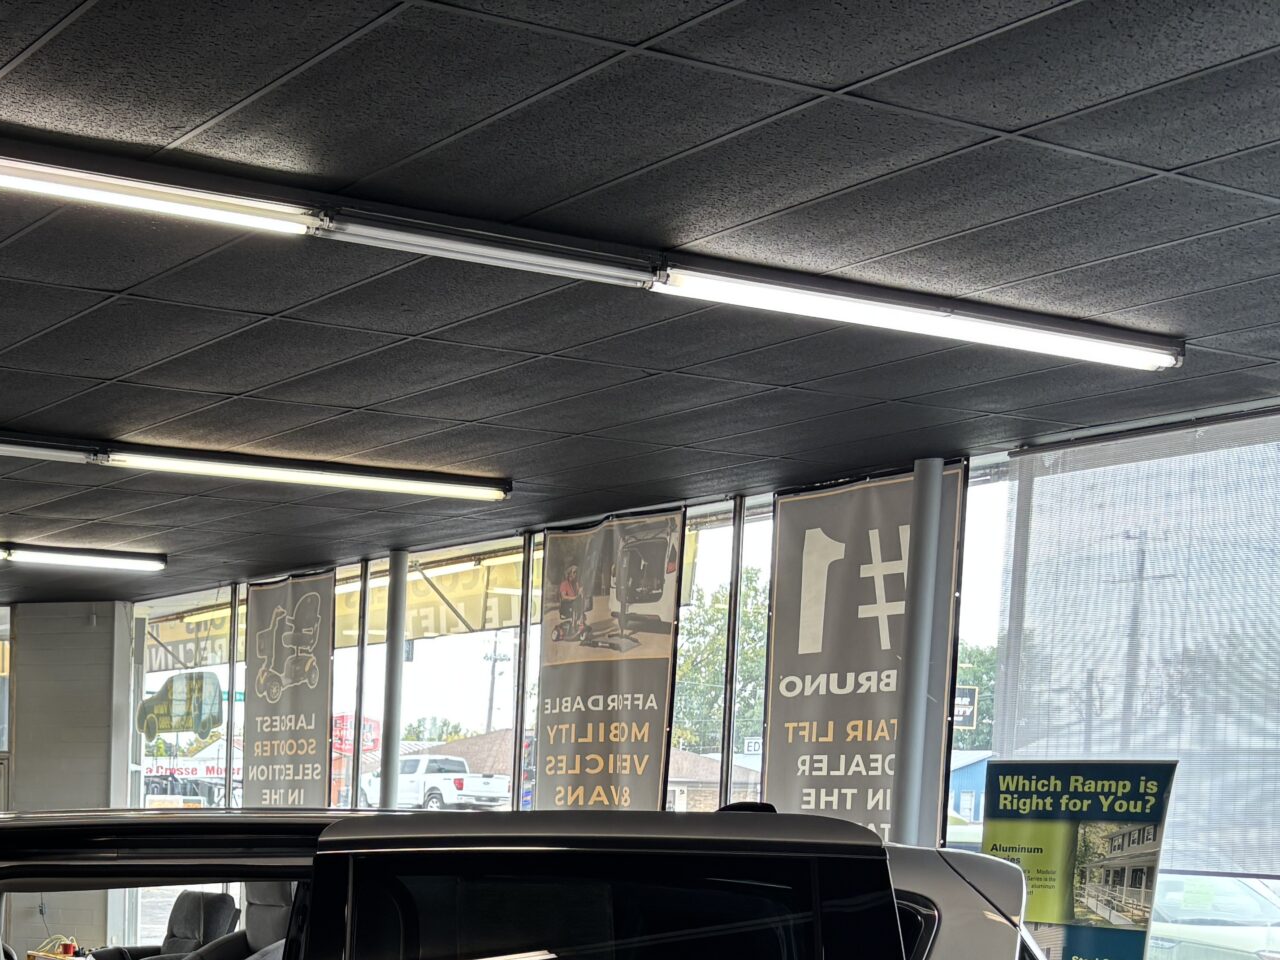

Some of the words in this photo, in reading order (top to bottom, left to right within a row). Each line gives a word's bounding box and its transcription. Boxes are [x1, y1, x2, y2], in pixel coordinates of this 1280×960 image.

[998, 775, 1062, 792] Which
[1070, 775, 1132, 796] Ramp
[1138, 776, 1159, 794] is
[998, 794, 1053, 814] Right
[1059, 794, 1092, 812] for
[1099, 795, 1156, 814] You?
[990, 843, 1044, 854] Aluminum
